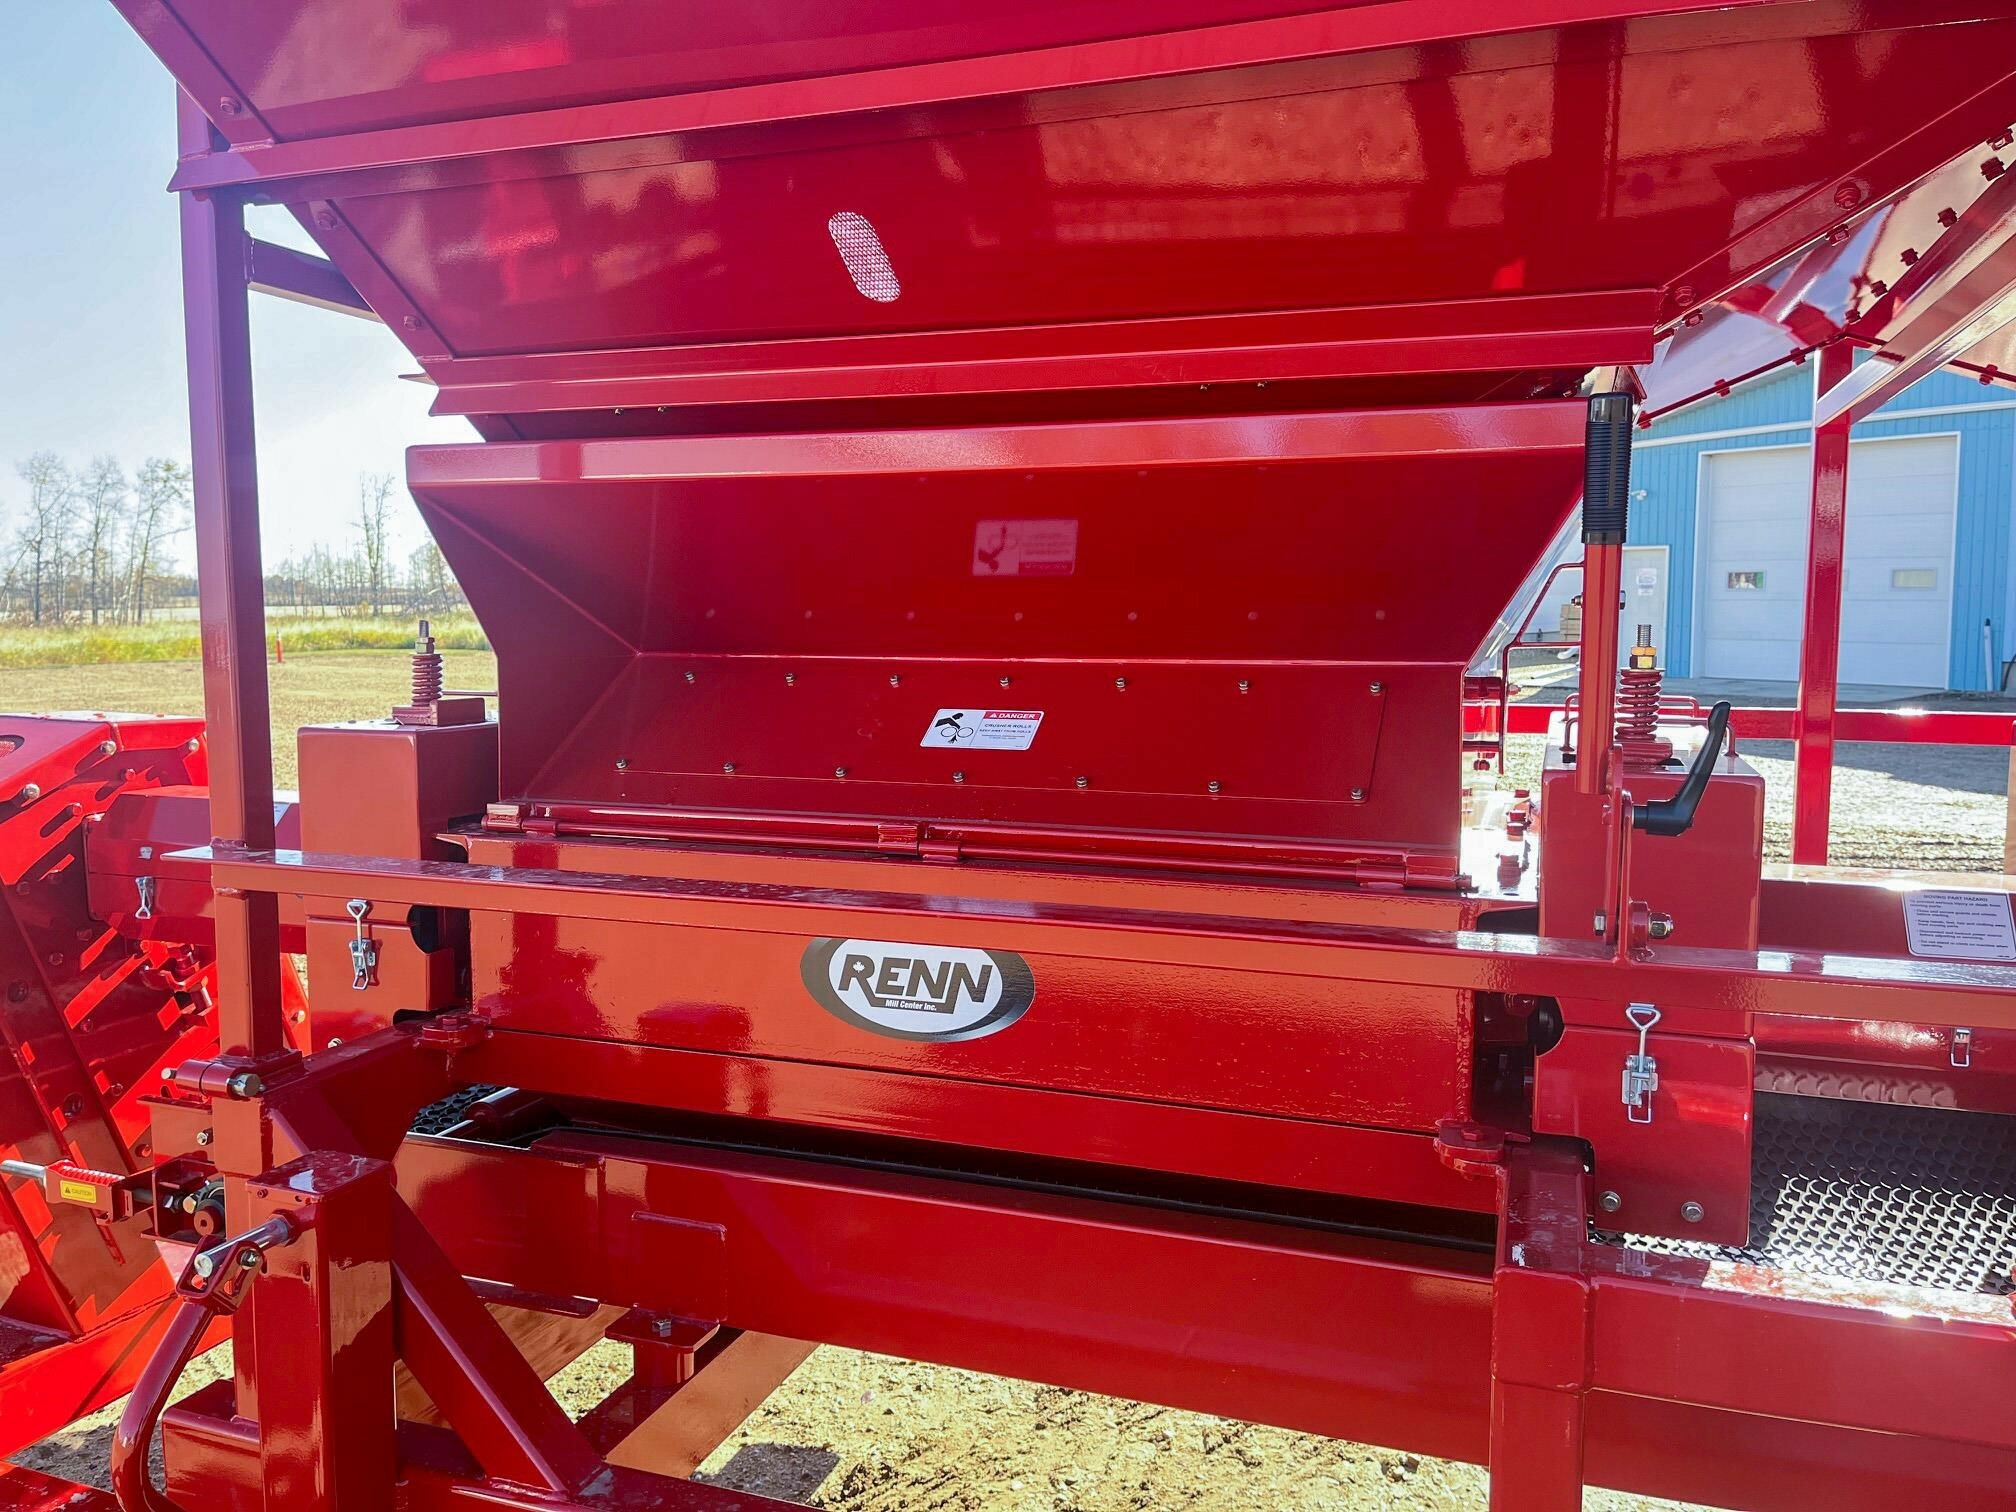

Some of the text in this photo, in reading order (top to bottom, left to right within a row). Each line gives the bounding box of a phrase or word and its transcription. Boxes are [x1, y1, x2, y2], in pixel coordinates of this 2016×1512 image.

[838, 954, 993, 1013] RENN
[885, 999, 937, 1011] Mill Center Inc.
